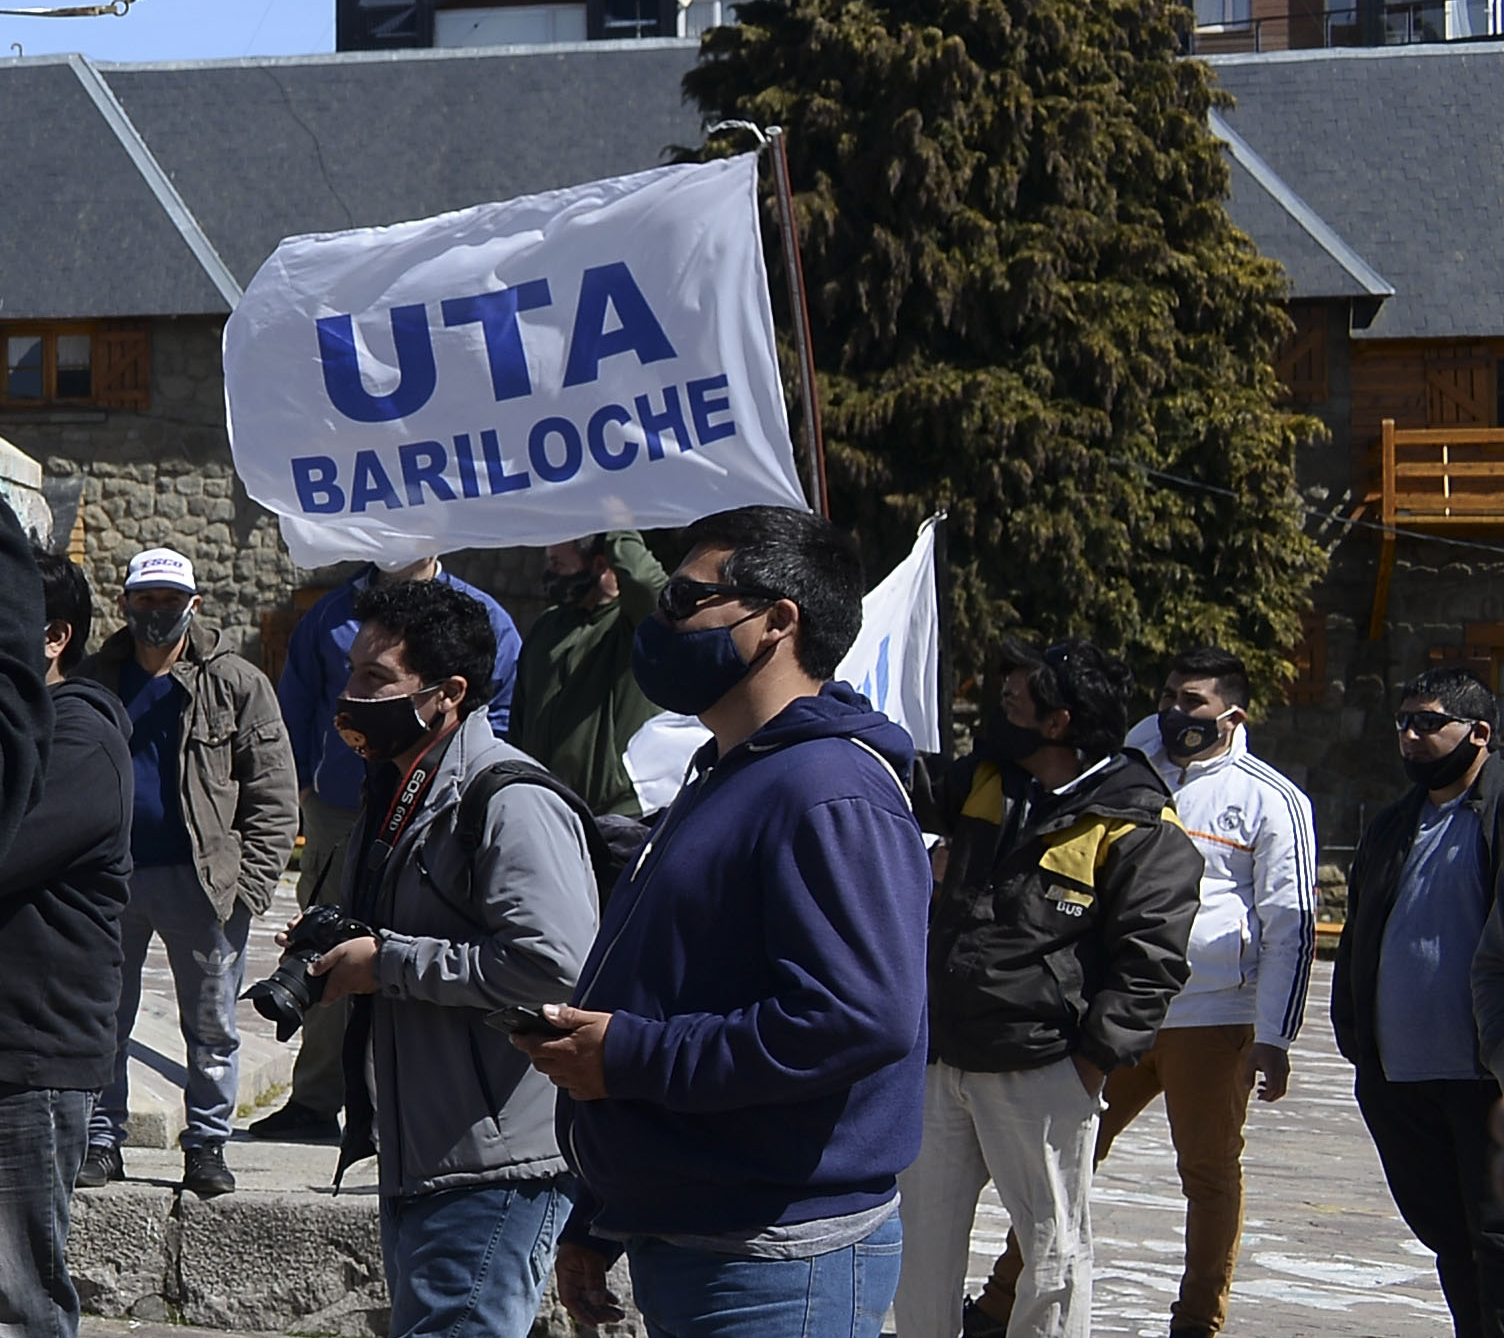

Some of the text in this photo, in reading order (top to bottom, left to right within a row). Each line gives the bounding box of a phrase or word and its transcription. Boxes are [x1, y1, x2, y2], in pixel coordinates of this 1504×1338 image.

[316, 260, 676, 423] UTA
[291, 375, 737, 513] BARILOCHE
[401, 769, 427, 804] EOS
[1056, 901, 1084, 917] BUS
